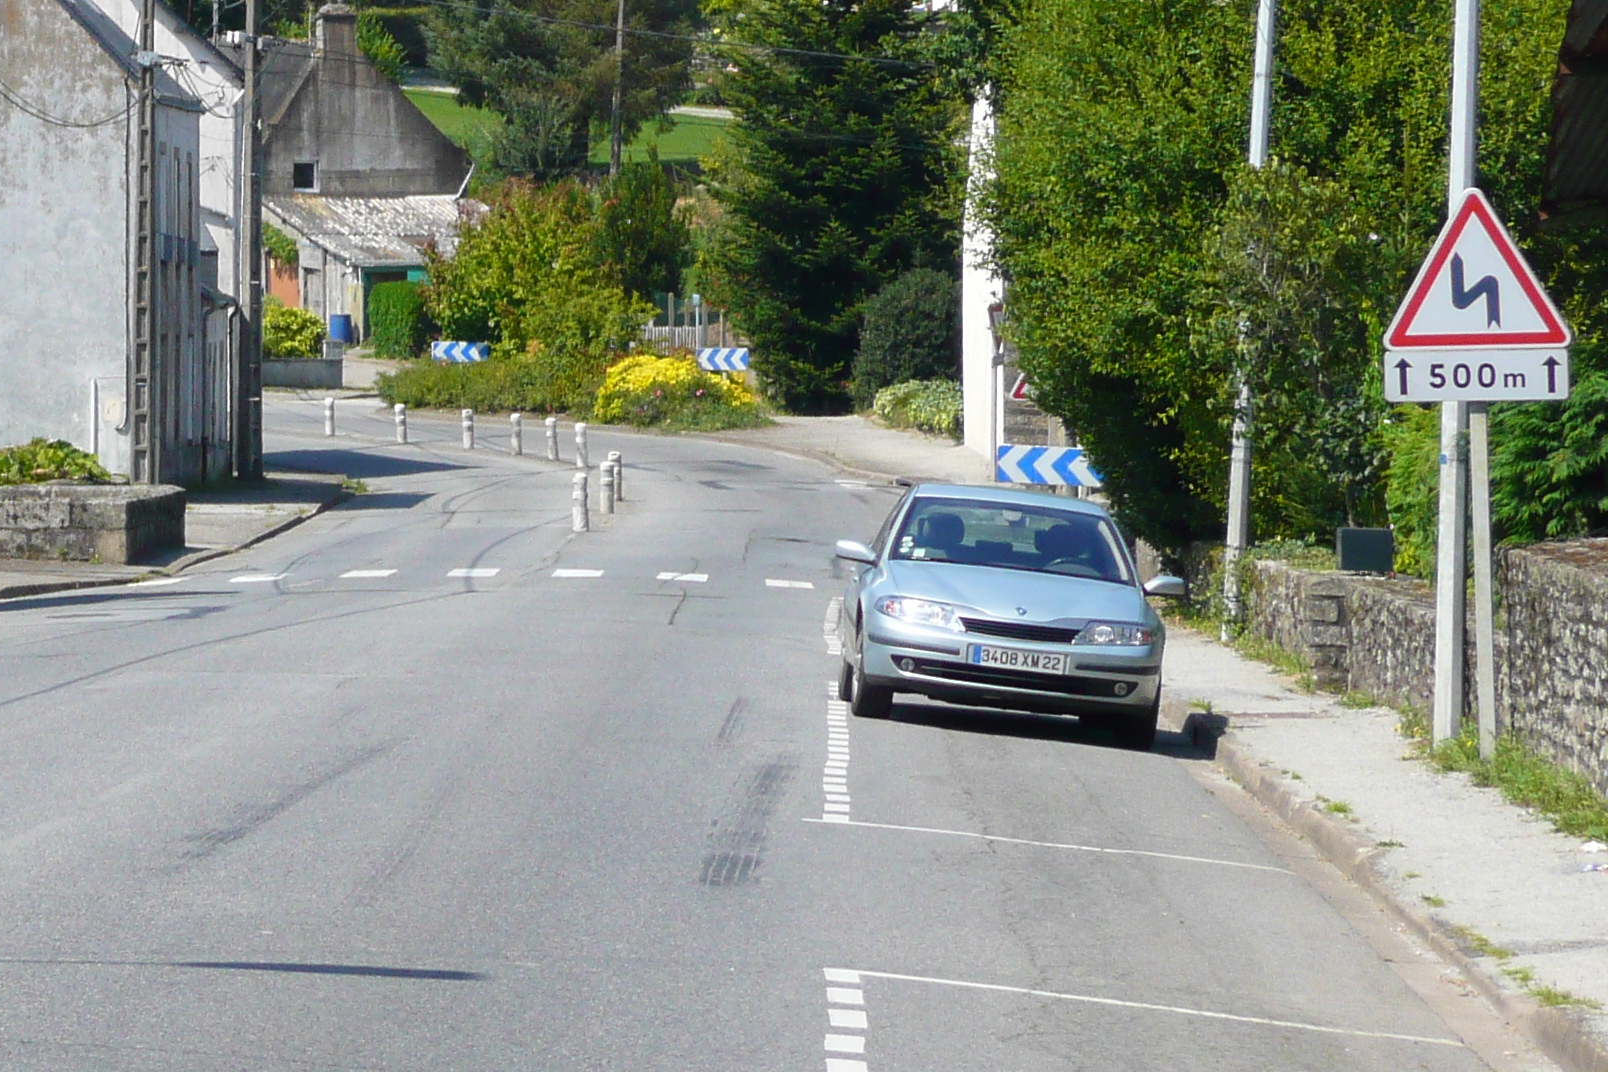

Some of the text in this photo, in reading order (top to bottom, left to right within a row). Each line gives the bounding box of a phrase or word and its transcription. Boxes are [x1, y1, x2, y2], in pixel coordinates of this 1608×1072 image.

[982, 648, 1061, 671] 3408 XM 22
